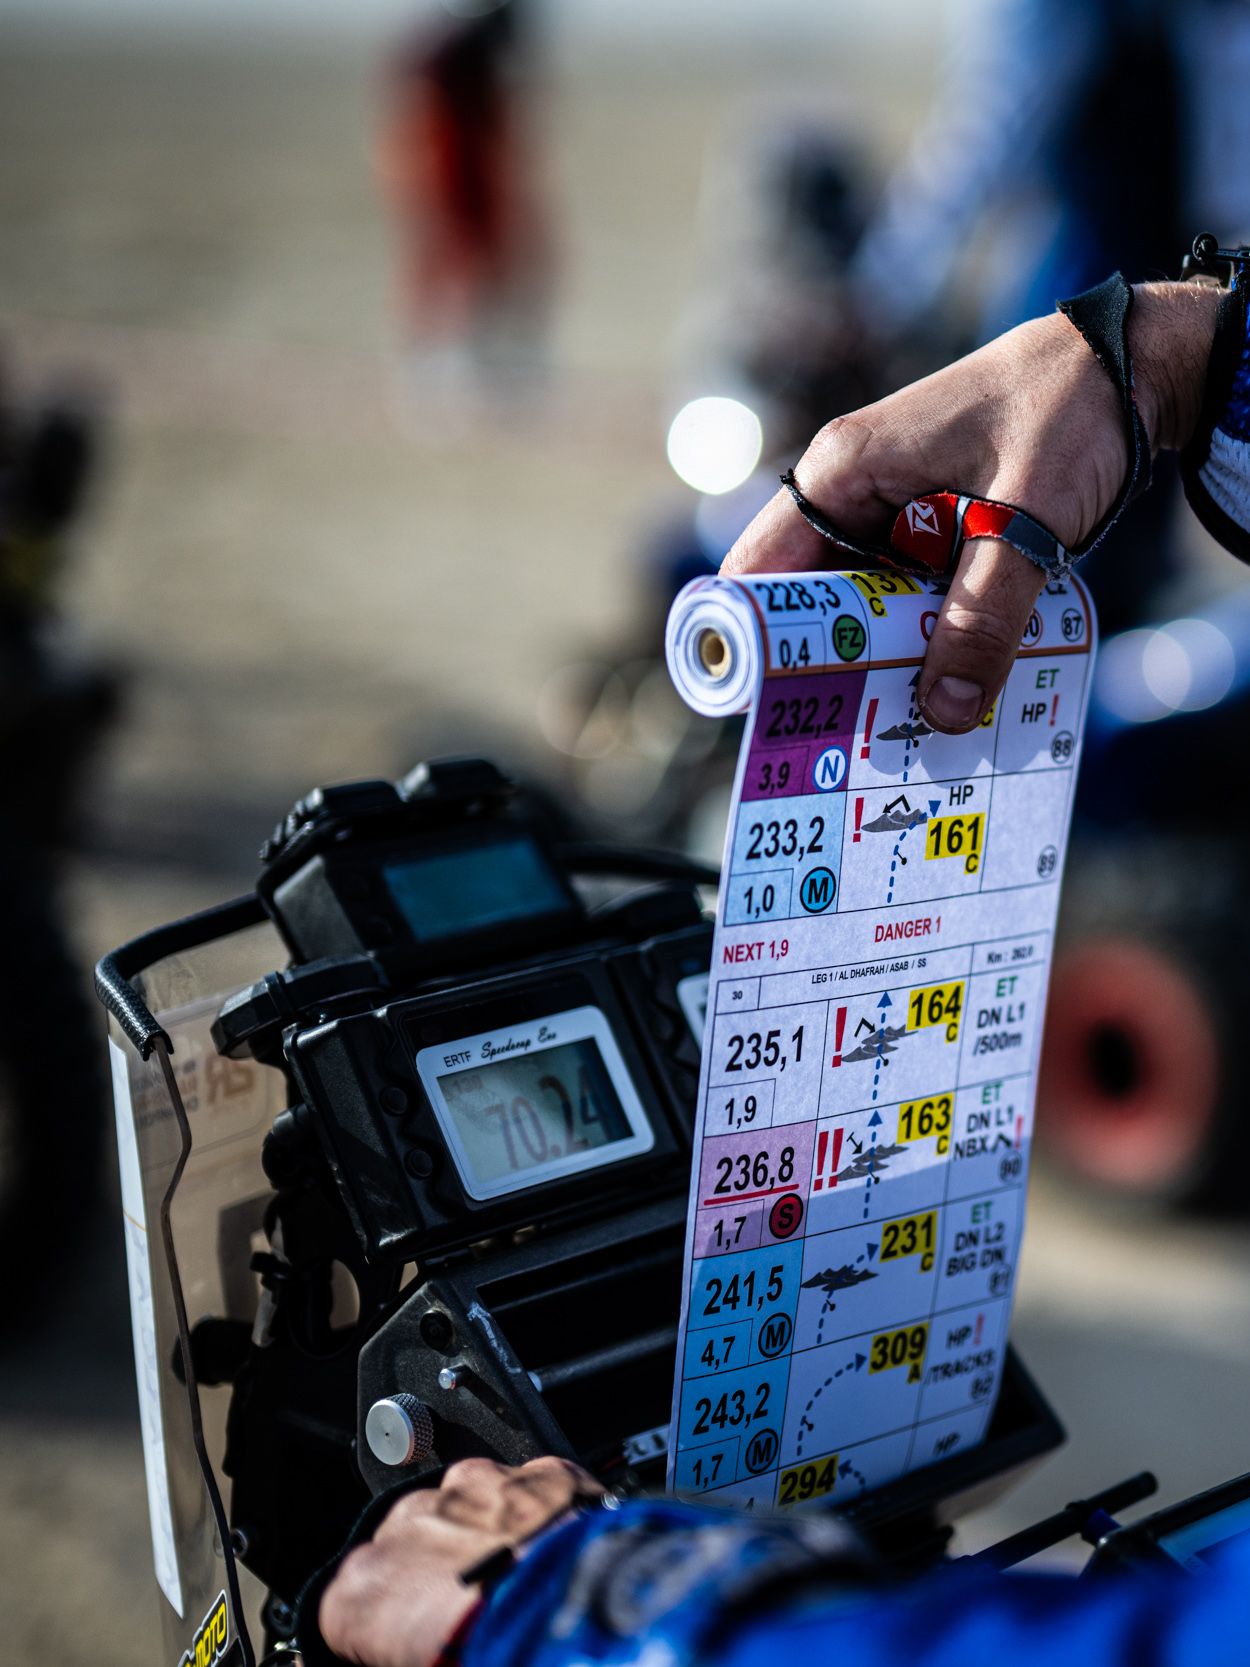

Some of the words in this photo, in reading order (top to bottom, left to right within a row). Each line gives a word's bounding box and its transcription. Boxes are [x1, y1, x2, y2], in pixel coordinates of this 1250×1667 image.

[850, 572, 917, 594] 131
[755, 580, 841, 616] 228,3
[869, 597, 885, 616] C
[837, 627, 861, 648] FZ
[1063, 616, 1082, 635] 87
[779, 637, 810, 671] 0,4
[1036, 669, 1060, 689] ET
[766, 695, 843, 739] 232,2
[1021, 703, 1046, 723] HP
[1053, 739, 1072, 757] 88
[759, 761, 790, 795] 3,9
[821, 755, 838, 784] N
[949, 785, 974, 806] HP
[746, 816, 825, 862] 233,2
[930, 816, 980, 856] 161
[965, 853, 978, 873] C
[744, 884, 774, 917] 1,0
[808, 877, 828, 903] M
[874, 918, 930, 943] DANGER
[931, 916, 941, 933] 1
[723, 941, 764, 964] NEXT
[769, 939, 789, 961] 1,9
[987, 952, 1002, 963] Km
[811, 973, 827, 985] LEG
[829, 972, 833, 982] 1
[839, 971, 848, 980] AL
[850, 965, 885, 979] DHAFRAH
[889, 961, 909, 972] ASAB
[917, 958, 927, 968] SS
[732, 990, 743, 1000] 30
[996, 976, 1018, 997] ET
[911, 985, 961, 1027] 164
[977, 1009, 1000, 1029] DN
[1006, 1002, 1025, 1023] L1
[946, 1022, 958, 1042] C
[973, 1033, 1021, 1056] /500m
[443, 1050, 472, 1068] ERTF
[725, 1025, 804, 1073] 235,1
[981, 1082, 1003, 1104] ET
[485, 1066, 607, 1170] 70.24
[724, 1095, 757, 1129] 1,9
[901, 1098, 950, 1139] 163
[967, 1112, 989, 1133] DN
[995, 1106, 1013, 1126] L1
[936, 1134, 948, 1154] C
[953, 1136, 987, 1161] NBX
[713, 1146, 795, 1194] 236,8
[778, 1203, 794, 1229] S
[971, 1201, 993, 1224] ET
[713, 1215, 747, 1252] 1,7
[882, 1213, 934, 1258] 231
[954, 1230, 978, 1252] DN
[984, 1223, 1004, 1243] L2
[921, 1252, 934, 1272] C
[946, 1252, 977, 1278] BIG
[980, 1246, 1006, 1268] DN
[703, 1264, 784, 1316] 241,5
[764, 1323, 786, 1349] M
[870, 1326, 927, 1371] 309
[947, 1326, 971, 1349] HP
[701, 1335, 735, 1370] 4,7
[909, 1363, 921, 1384] A
[692, 1382, 771, 1436] 243,2
[752, 1439, 773, 1466] M
[691, 1453, 725, 1488] 1,7
[779, 1458, 838, 1504] 294
